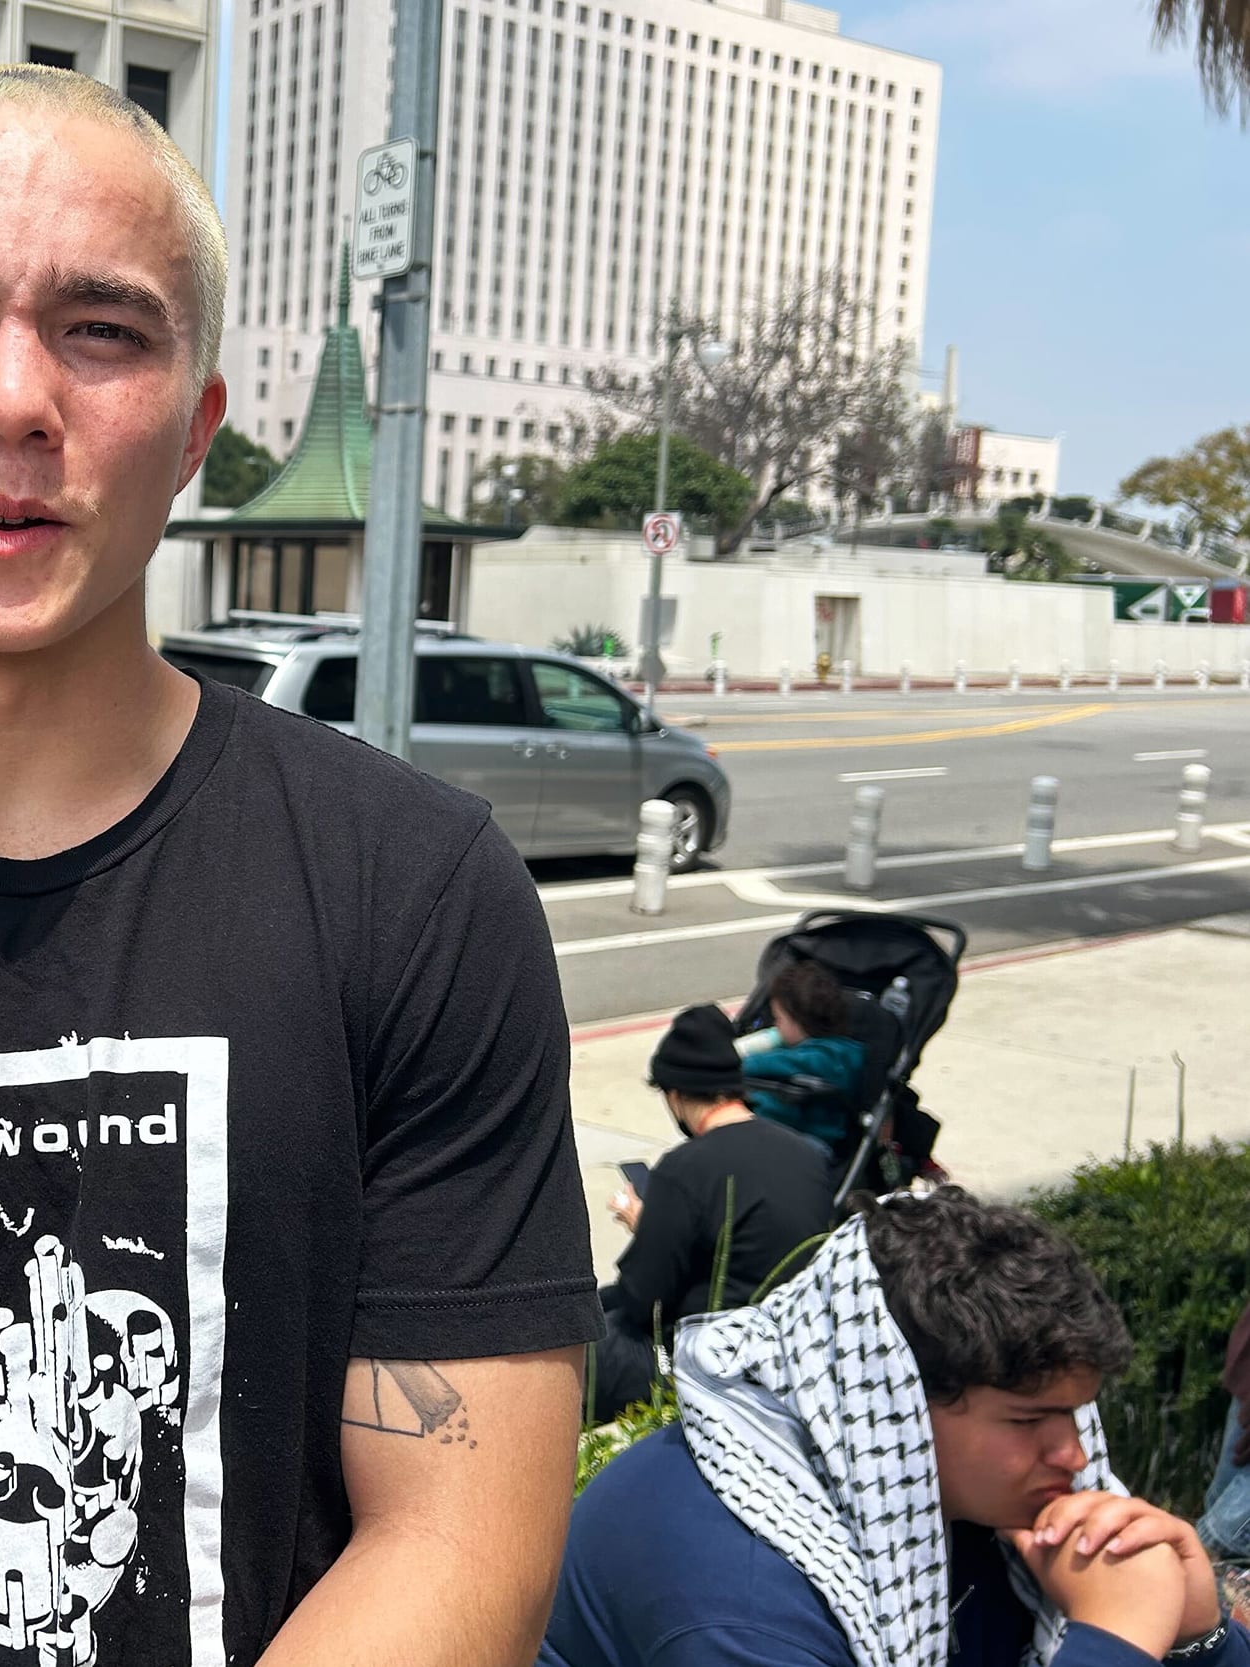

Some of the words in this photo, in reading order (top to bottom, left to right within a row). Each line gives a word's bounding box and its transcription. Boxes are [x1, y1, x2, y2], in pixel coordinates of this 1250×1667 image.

[358, 208, 376, 224] ALL
[378, 199, 407, 219] TURNS
[369, 222, 395, 242] FROM
[357, 246, 378, 264] BIKE
[380, 241, 406, 260] LANE
